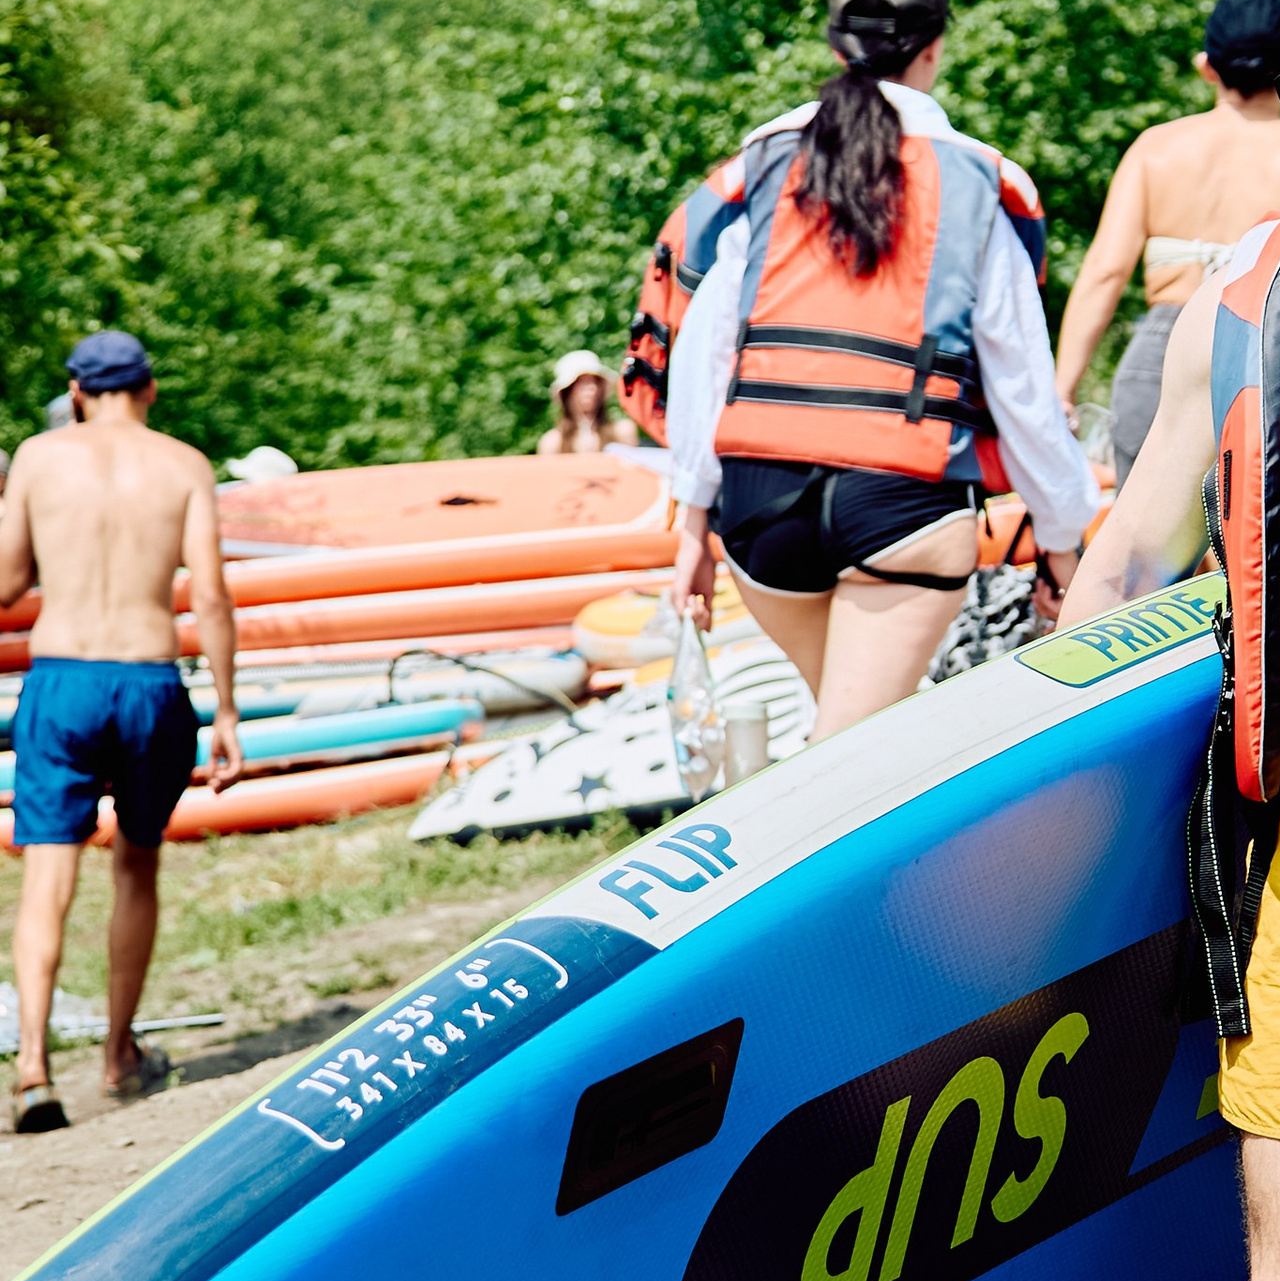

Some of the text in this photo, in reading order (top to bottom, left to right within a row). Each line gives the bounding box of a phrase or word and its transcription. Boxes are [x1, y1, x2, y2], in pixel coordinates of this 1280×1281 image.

[1067, 592, 1216, 663] PRIME
[598, 823, 739, 921] FLIP
[336, 1070, 399, 1121] 341
[423, 1021, 467, 1056] 84
[489, 978, 530, 1009] 15
